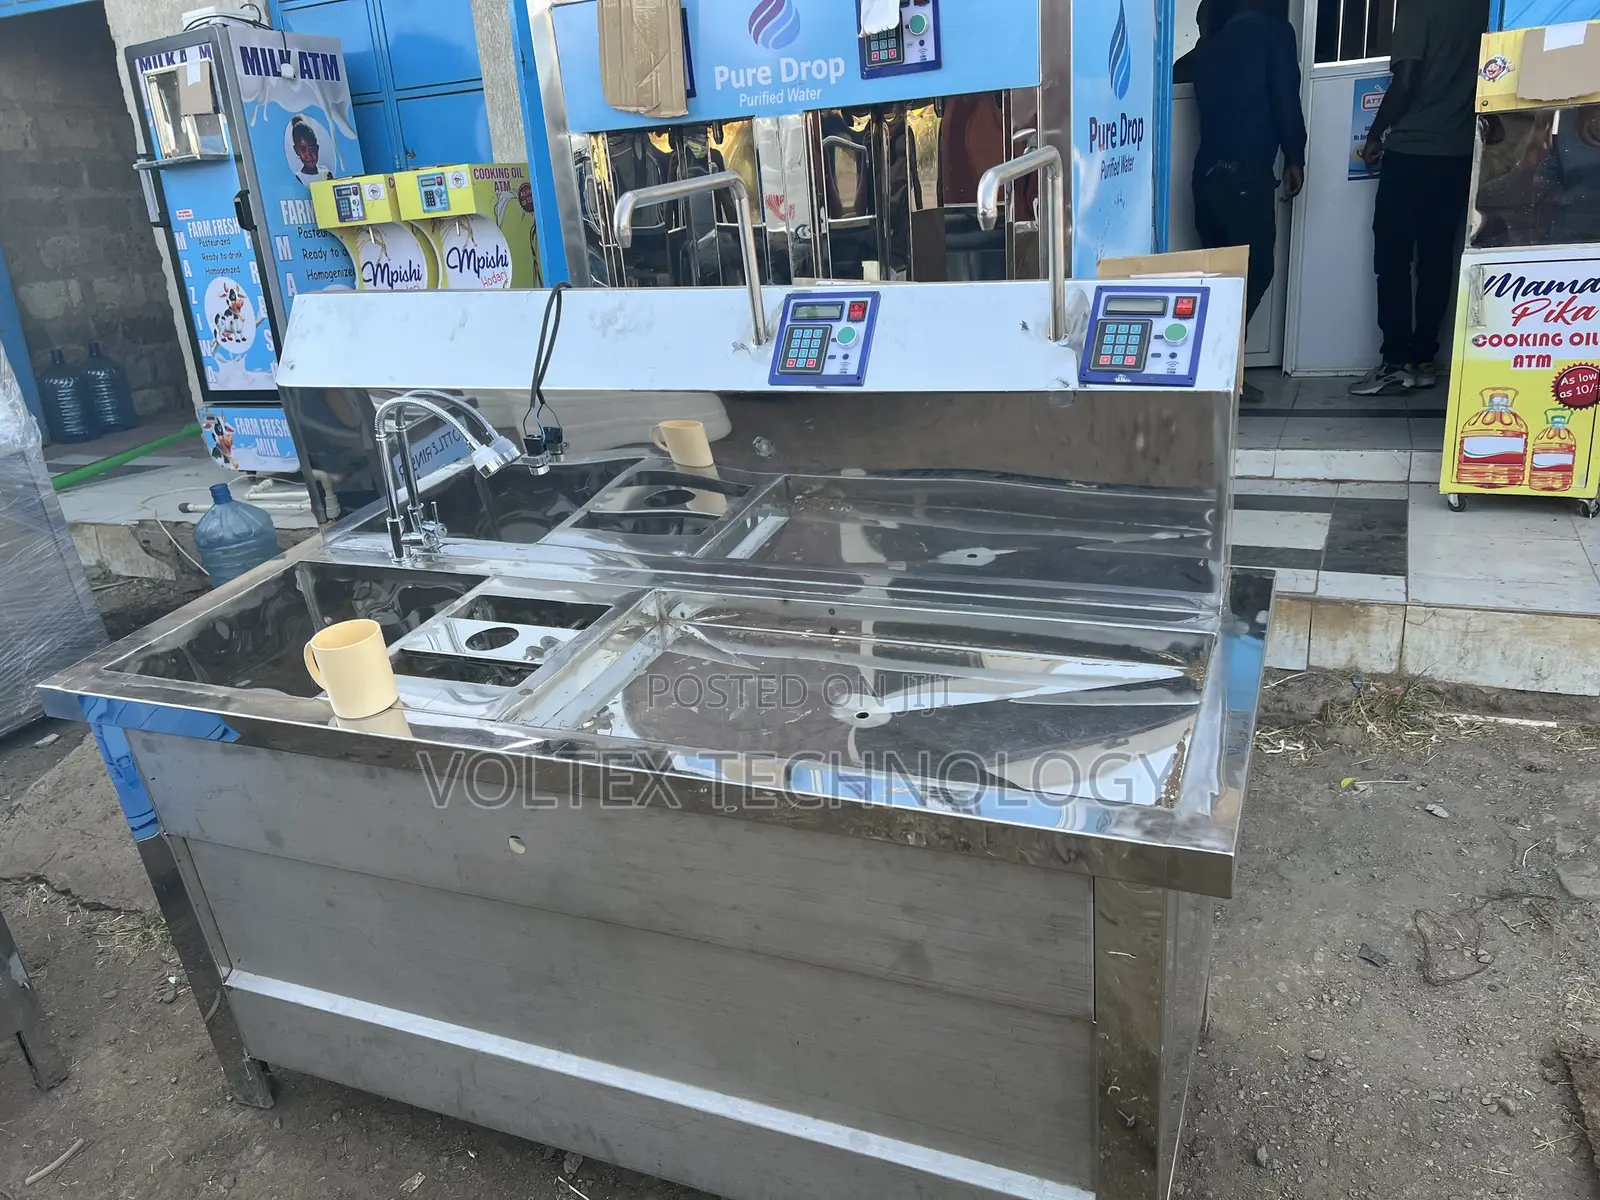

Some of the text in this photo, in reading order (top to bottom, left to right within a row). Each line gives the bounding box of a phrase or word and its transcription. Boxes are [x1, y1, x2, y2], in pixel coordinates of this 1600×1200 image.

[138, 43, 213, 73] MILK AM
[239, 46, 341, 82] MILK ATM
[714, 57, 845, 91] Pure Drop
[739, 87, 823, 108] Purified Water
[1089, 112, 1144, 154] Pure Drop
[473, 166, 525, 180] COOKING OIL
[1100, 154, 1135, 180] Purified Water
[494, 180, 512, 193] ATM
[187, 217, 240, 238] FARM FRESH
[199, 237, 231, 248] Pasteurized
[201, 250, 243, 262] Ready to drink
[301, 246, 328, 262] Ready
[330, 247, 340, 258] to
[446, 244, 509, 279] Mpishi
[205, 264, 241, 276] Homogenized
[361, 259, 423, 290] Mpishi
[481, 270, 508, 288] Hodari
[1484, 272, 1600, 303] Mama
[1511, 295, 1600, 327] Pika
[1472, 332, 1599, 348] COOKING OIL
[1512, 353, 1552, 368] ATM
[1560, 372, 1597, 387] As low
[1559, 389, 1573, 399] as
[234, 416, 291, 438] FARM FRESH
[255, 437, 280, 457] MILK
